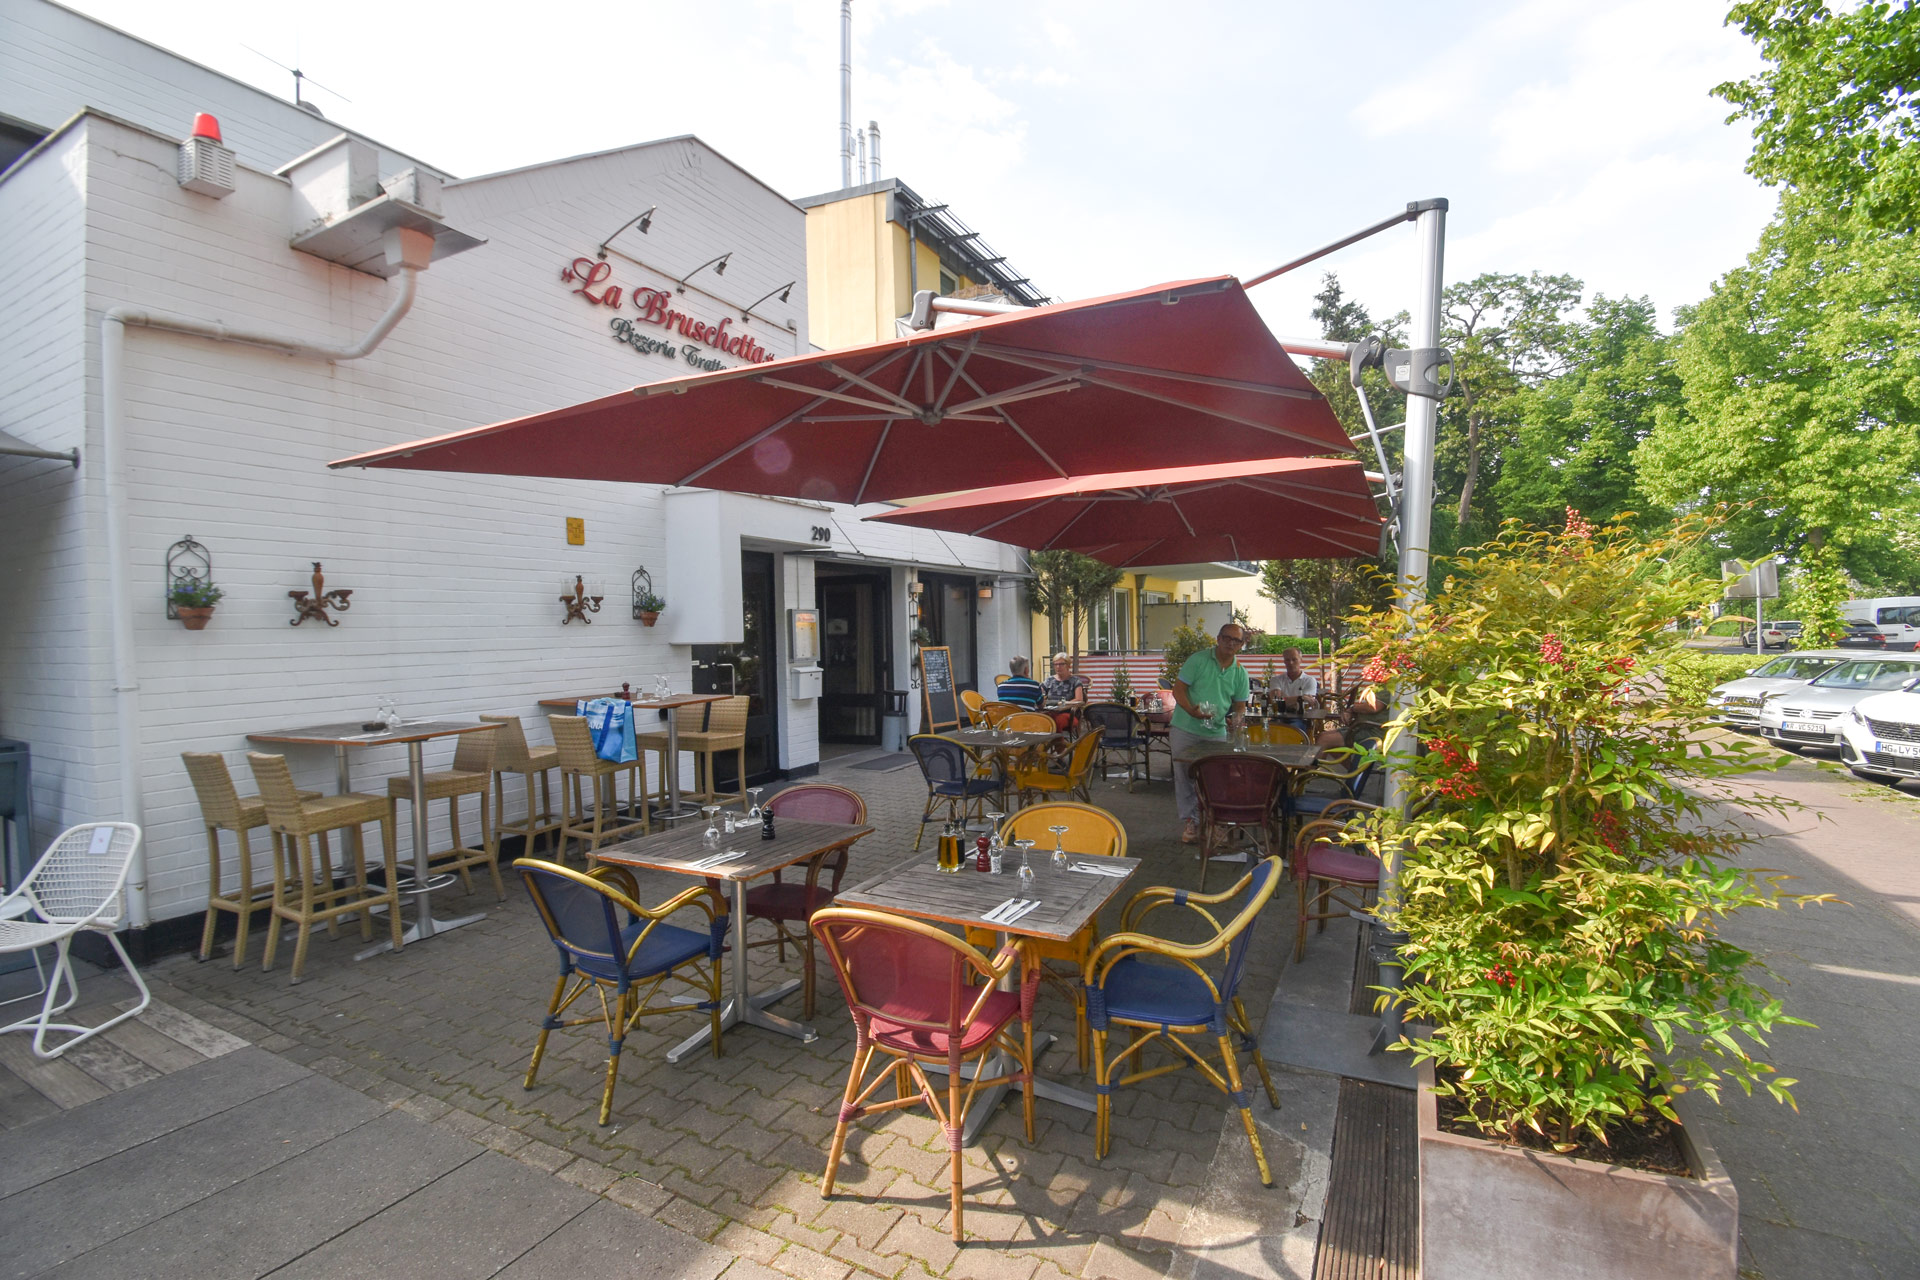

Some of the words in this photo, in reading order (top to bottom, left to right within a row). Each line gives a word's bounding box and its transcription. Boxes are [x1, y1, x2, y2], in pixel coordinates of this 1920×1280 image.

[610, 317, 676, 359] Pizzeria
[681, 344, 738, 372] Tratt
[811, 525, 831, 542] 290
[1912, 747, 1920, 756] 5
